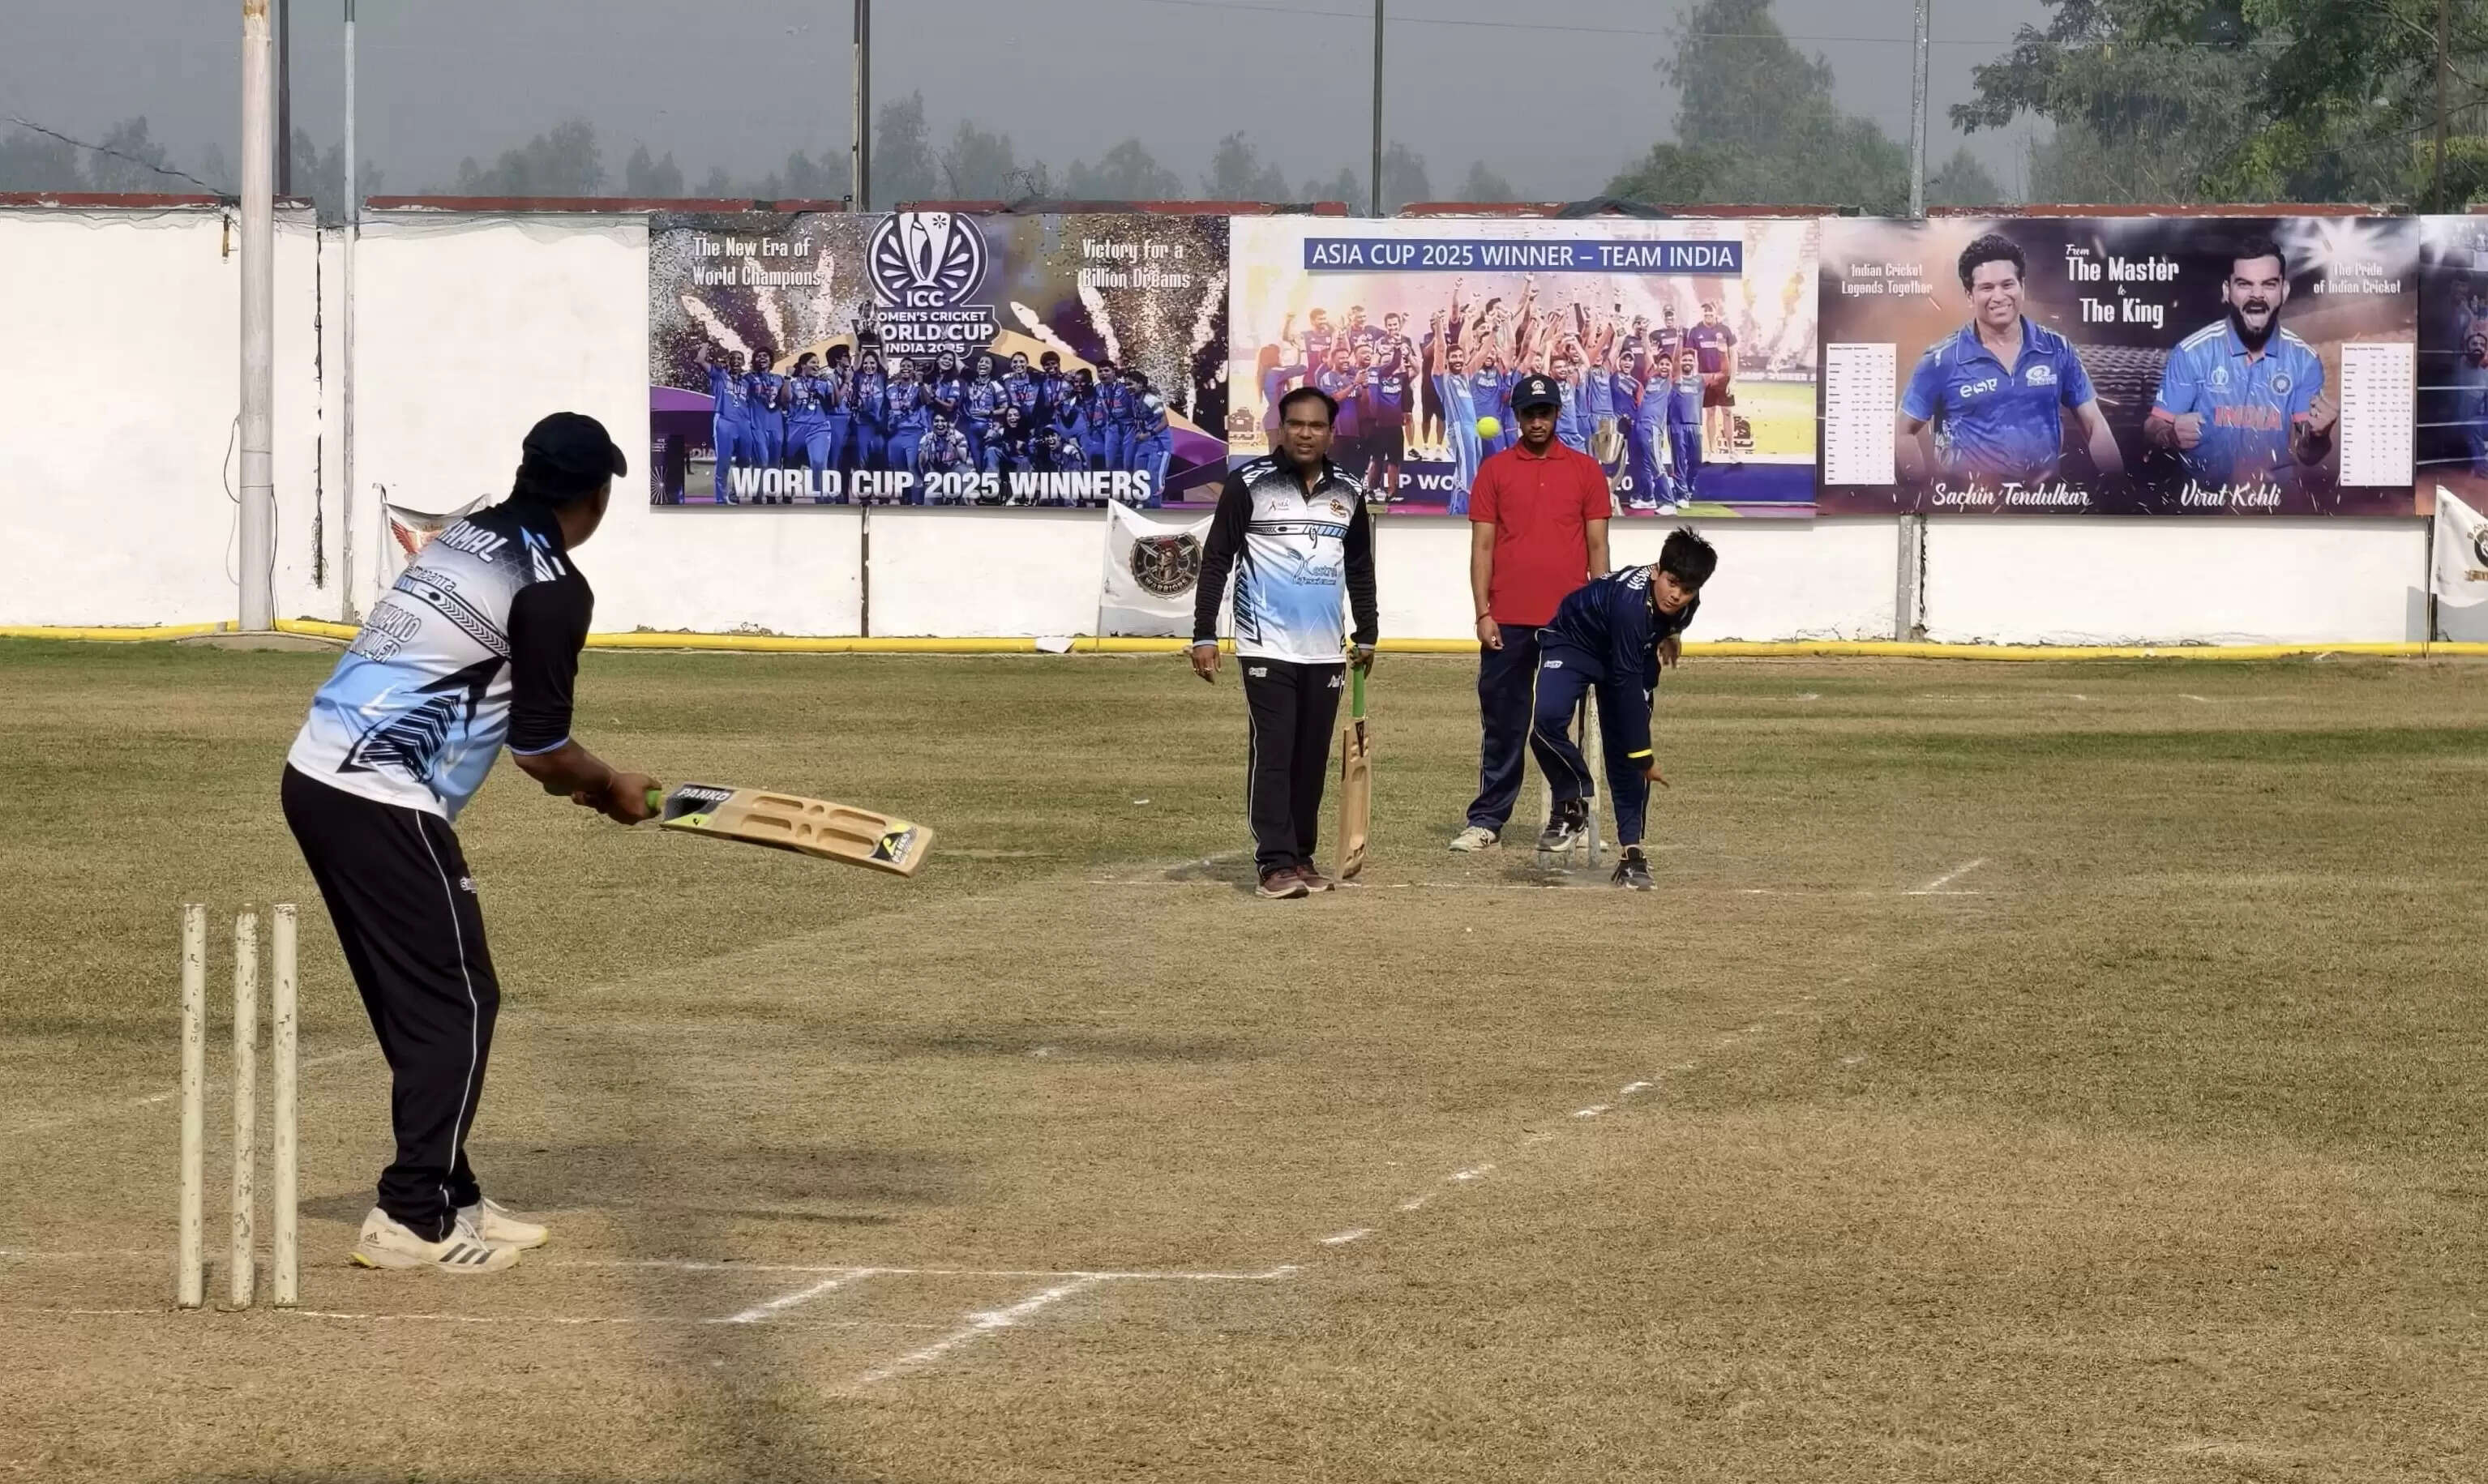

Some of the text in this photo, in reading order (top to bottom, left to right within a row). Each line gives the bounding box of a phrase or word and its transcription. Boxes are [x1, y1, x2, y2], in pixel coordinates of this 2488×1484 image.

[692, 237, 813, 257] The New Era of
[1082, 239, 1184, 263] Victory for a
[1312, 244, 1364, 264] ASIA
[1370, 245, 1415, 265] CUP
[1422, 246, 1473, 266] 2025
[1481, 246, 1574, 267] WINNER
[1599, 246, 1661, 267] TEAM
[1670, 246, 1734, 267] INDIA
[2066, 244, 2089, 256] From
[692, 266, 822, 291] World Champions
[1081, 268, 1191, 289] Billion Dreams
[1852, 263, 1923, 276] Indian Cricket
[2066, 256, 2180, 281] The Master
[2335, 262, 2383, 276] The Pride
[1842, 280, 1933, 297] Legends Together
[2314, 280, 2401, 293] of Indian Cricket
[906, 291, 944, 307] ICC
[877, 311, 987, 322] OMEN'S CRICKET
[2079, 297, 2164, 329] The King
[881, 324, 993, 340] ORLD CUP
[886, 343, 925, 353] INDIA
[732, 467, 1150, 501] WORLD CUP 2025 WINNERS
[2181, 478, 2282, 507] Virat Kohli
[1932, 482, 2093, 507] Sachin Tendulkar
